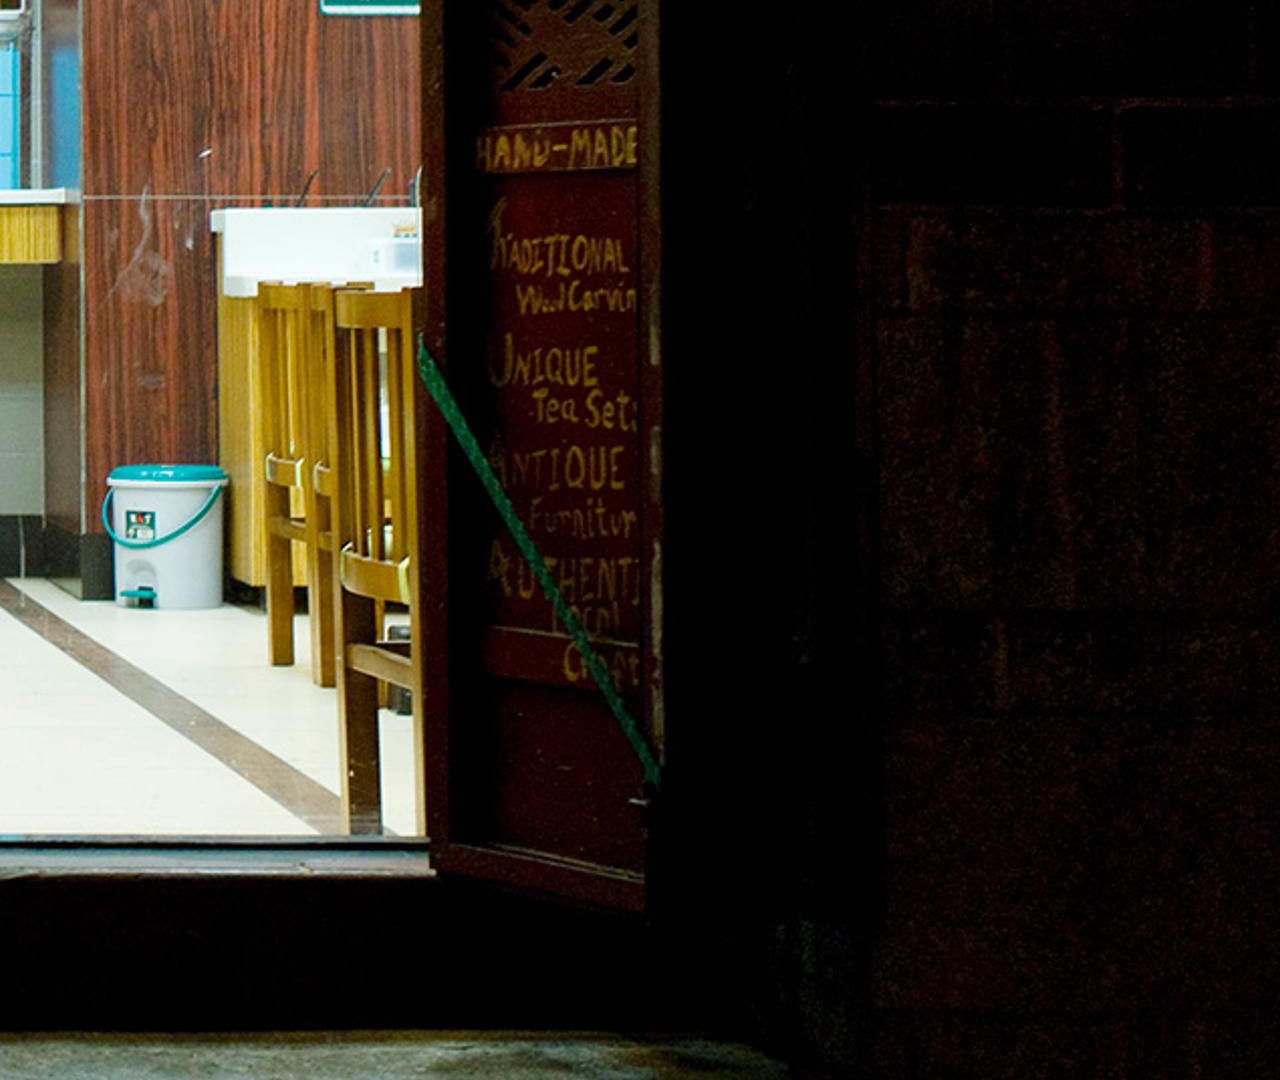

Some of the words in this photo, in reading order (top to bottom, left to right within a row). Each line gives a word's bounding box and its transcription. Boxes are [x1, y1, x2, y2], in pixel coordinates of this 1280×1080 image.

[475, 124, 638, 169] HAND-MADE
[487, 331, 601, 389] UNIQUE
[531, 386, 580, 424] Tea
